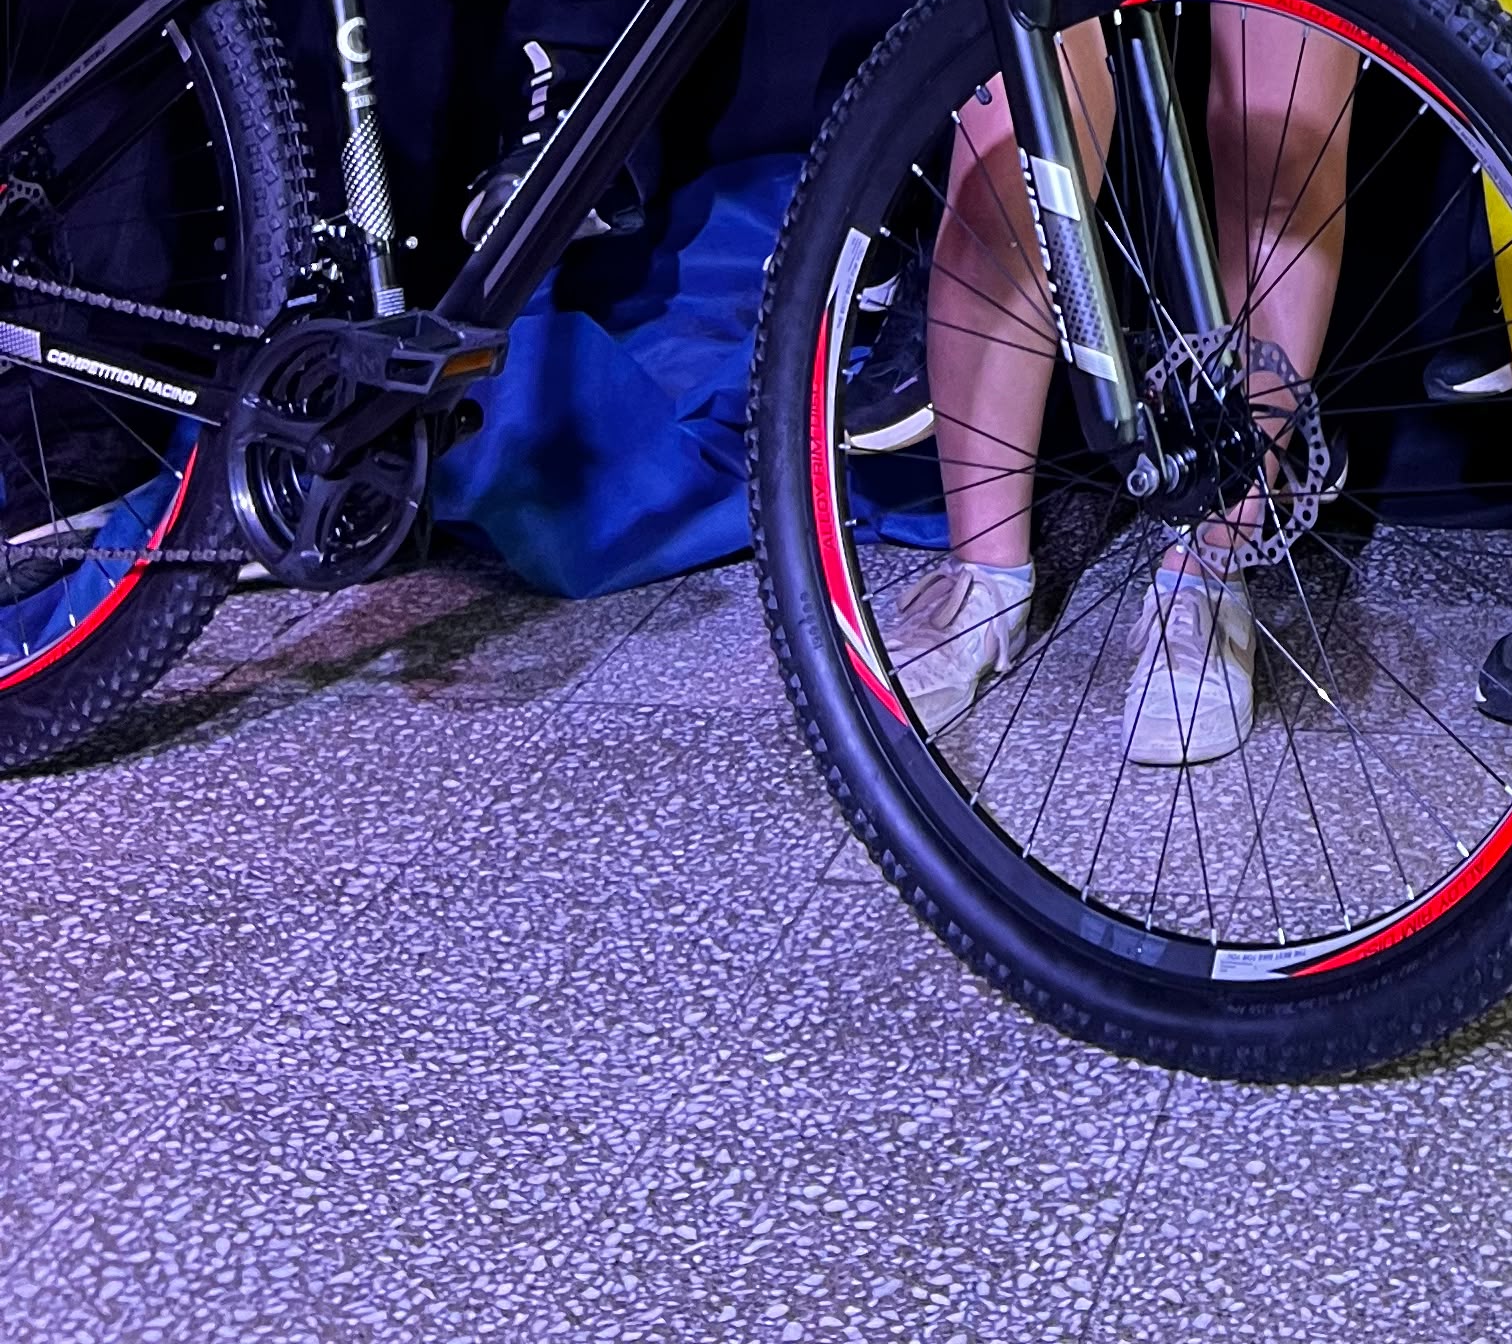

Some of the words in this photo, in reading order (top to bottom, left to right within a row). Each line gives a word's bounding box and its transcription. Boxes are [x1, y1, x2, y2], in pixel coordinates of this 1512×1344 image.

[47, 349, 144, 388] COMPETITION
[142, 377, 198, 406] RACING
[815, 485, 837, 552] ALLOY
